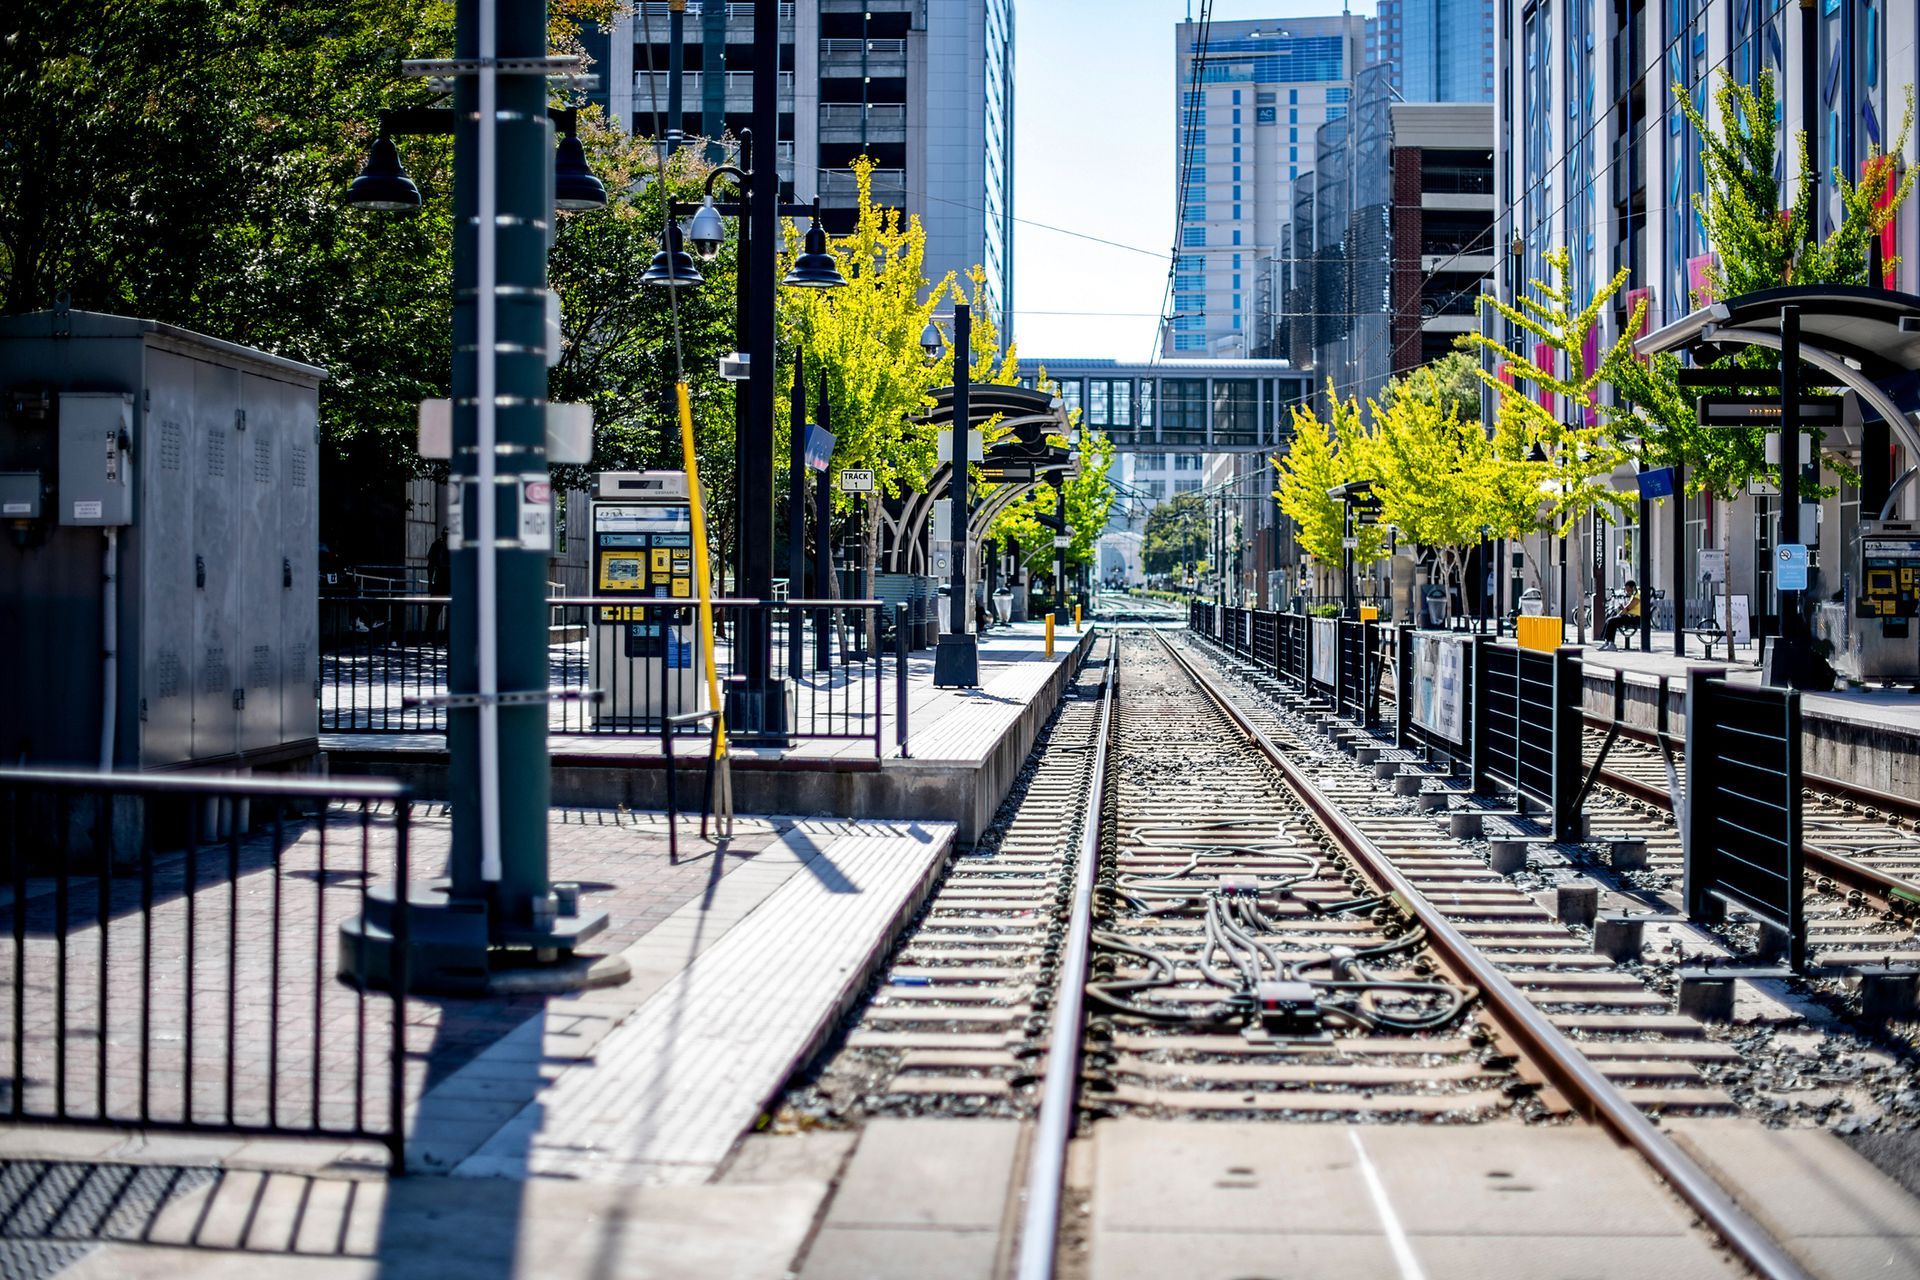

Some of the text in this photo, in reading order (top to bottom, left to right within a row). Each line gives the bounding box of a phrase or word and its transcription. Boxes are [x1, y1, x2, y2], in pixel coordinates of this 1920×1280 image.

[1259, 109, 1273, 117] AC
[844, 472, 868, 480] TRACK
[1761, 485, 1766, 493] 2
